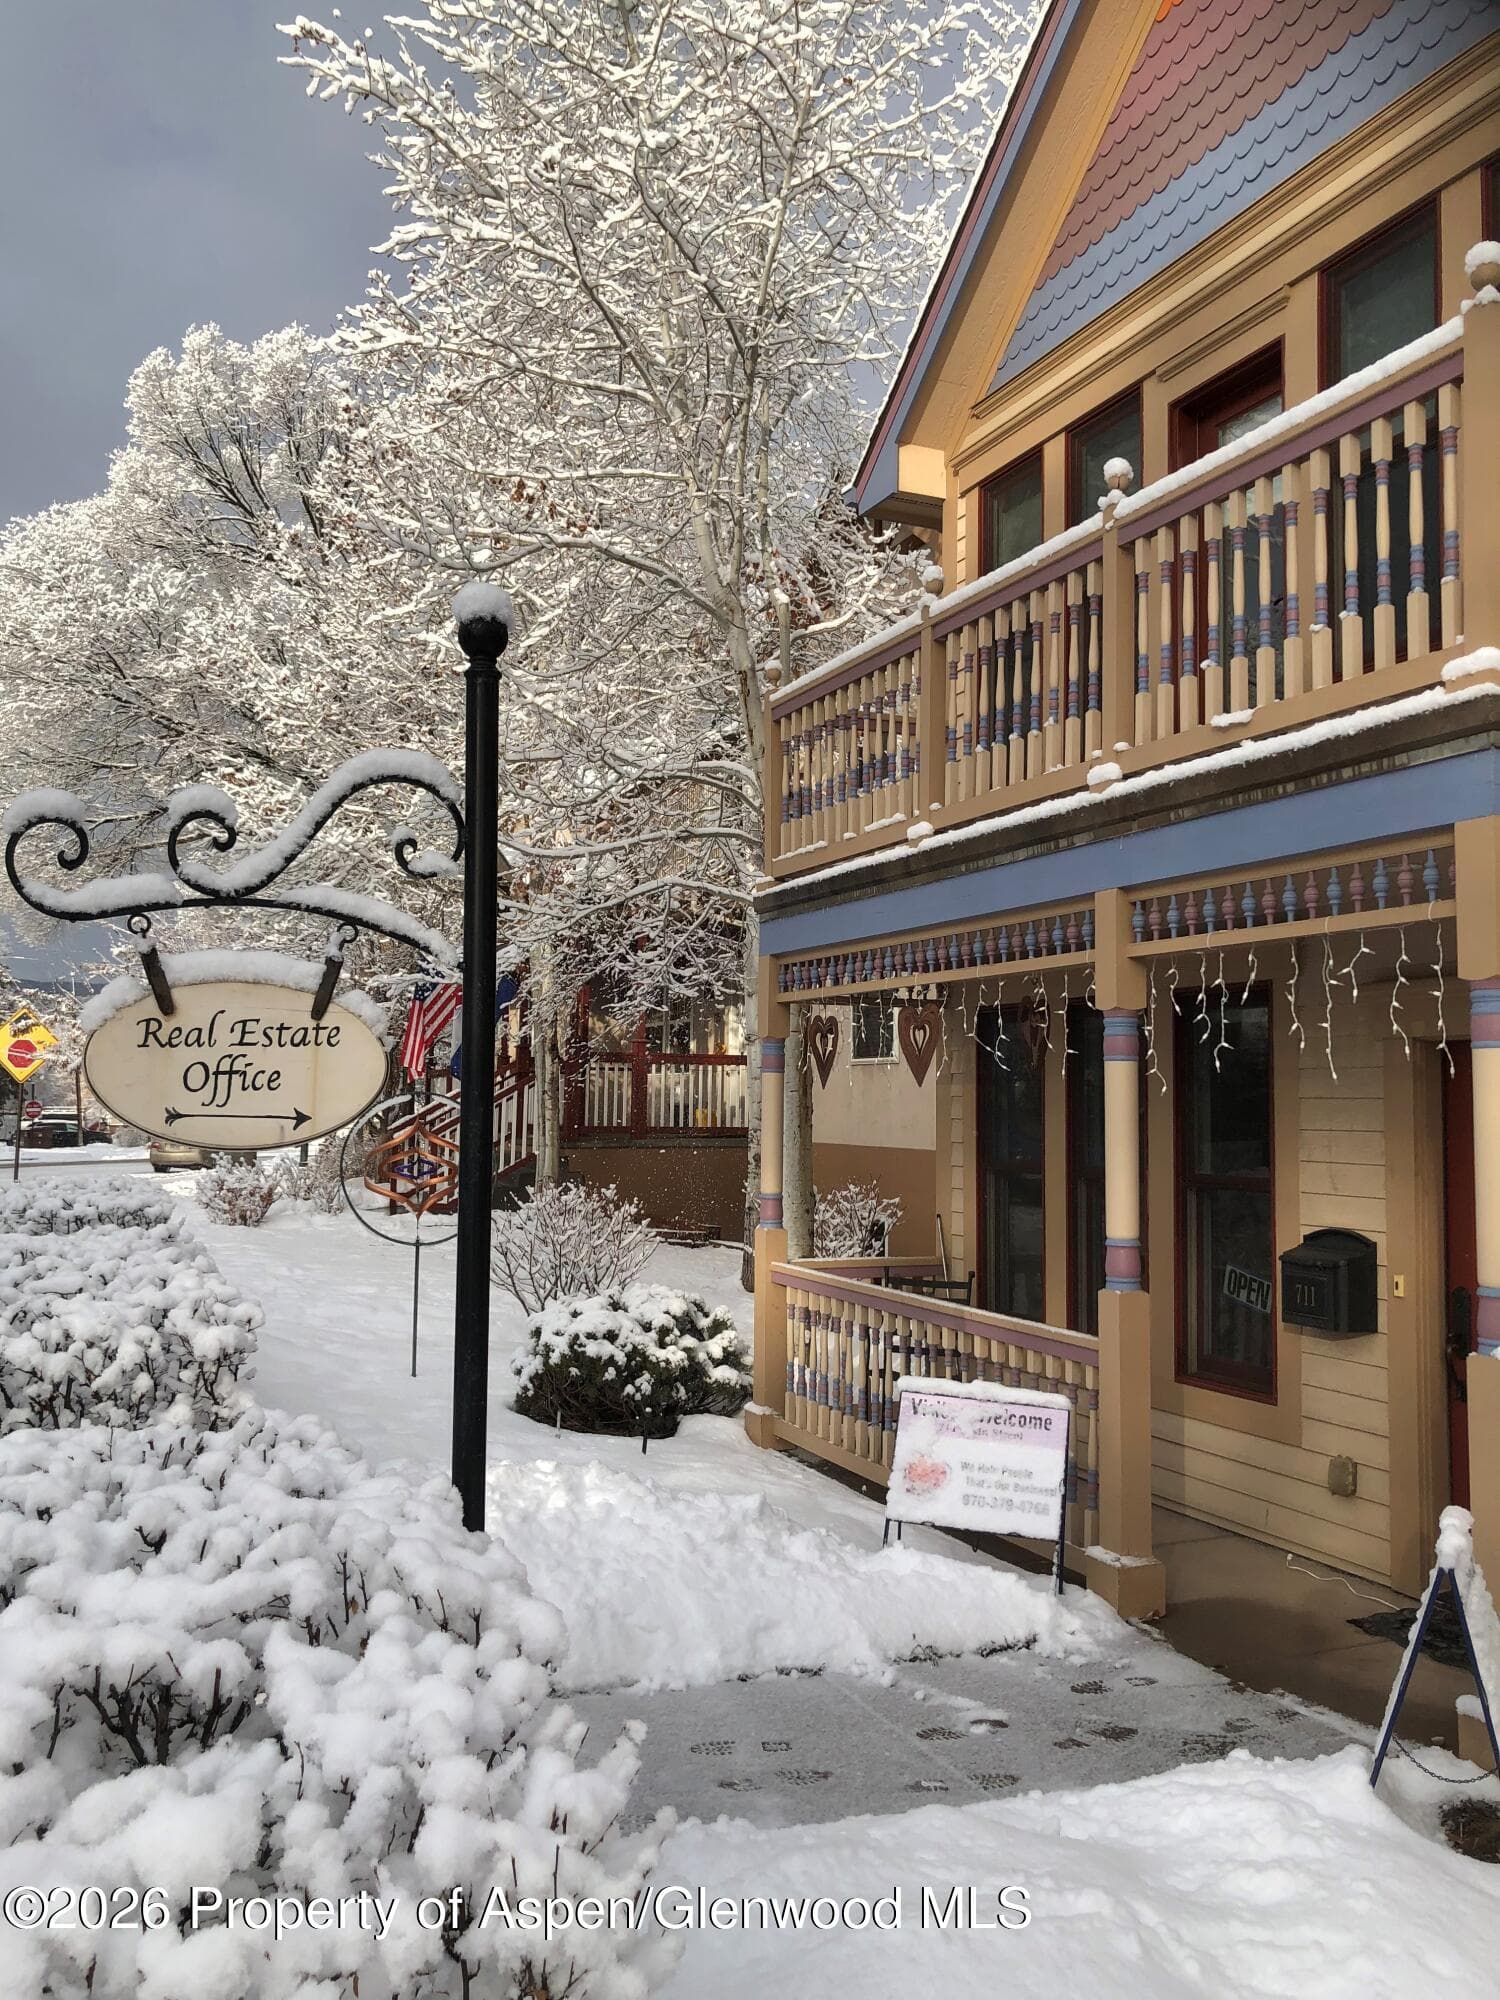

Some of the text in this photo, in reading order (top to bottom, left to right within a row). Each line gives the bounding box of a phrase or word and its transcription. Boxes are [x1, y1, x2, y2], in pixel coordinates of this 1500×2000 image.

[136, 1010, 340, 1048] Real Estate
[183, 1053, 281, 1107] Office
[1227, 1268, 1271, 1312] OPEN
[1296, 1284, 1315, 1307] 711
